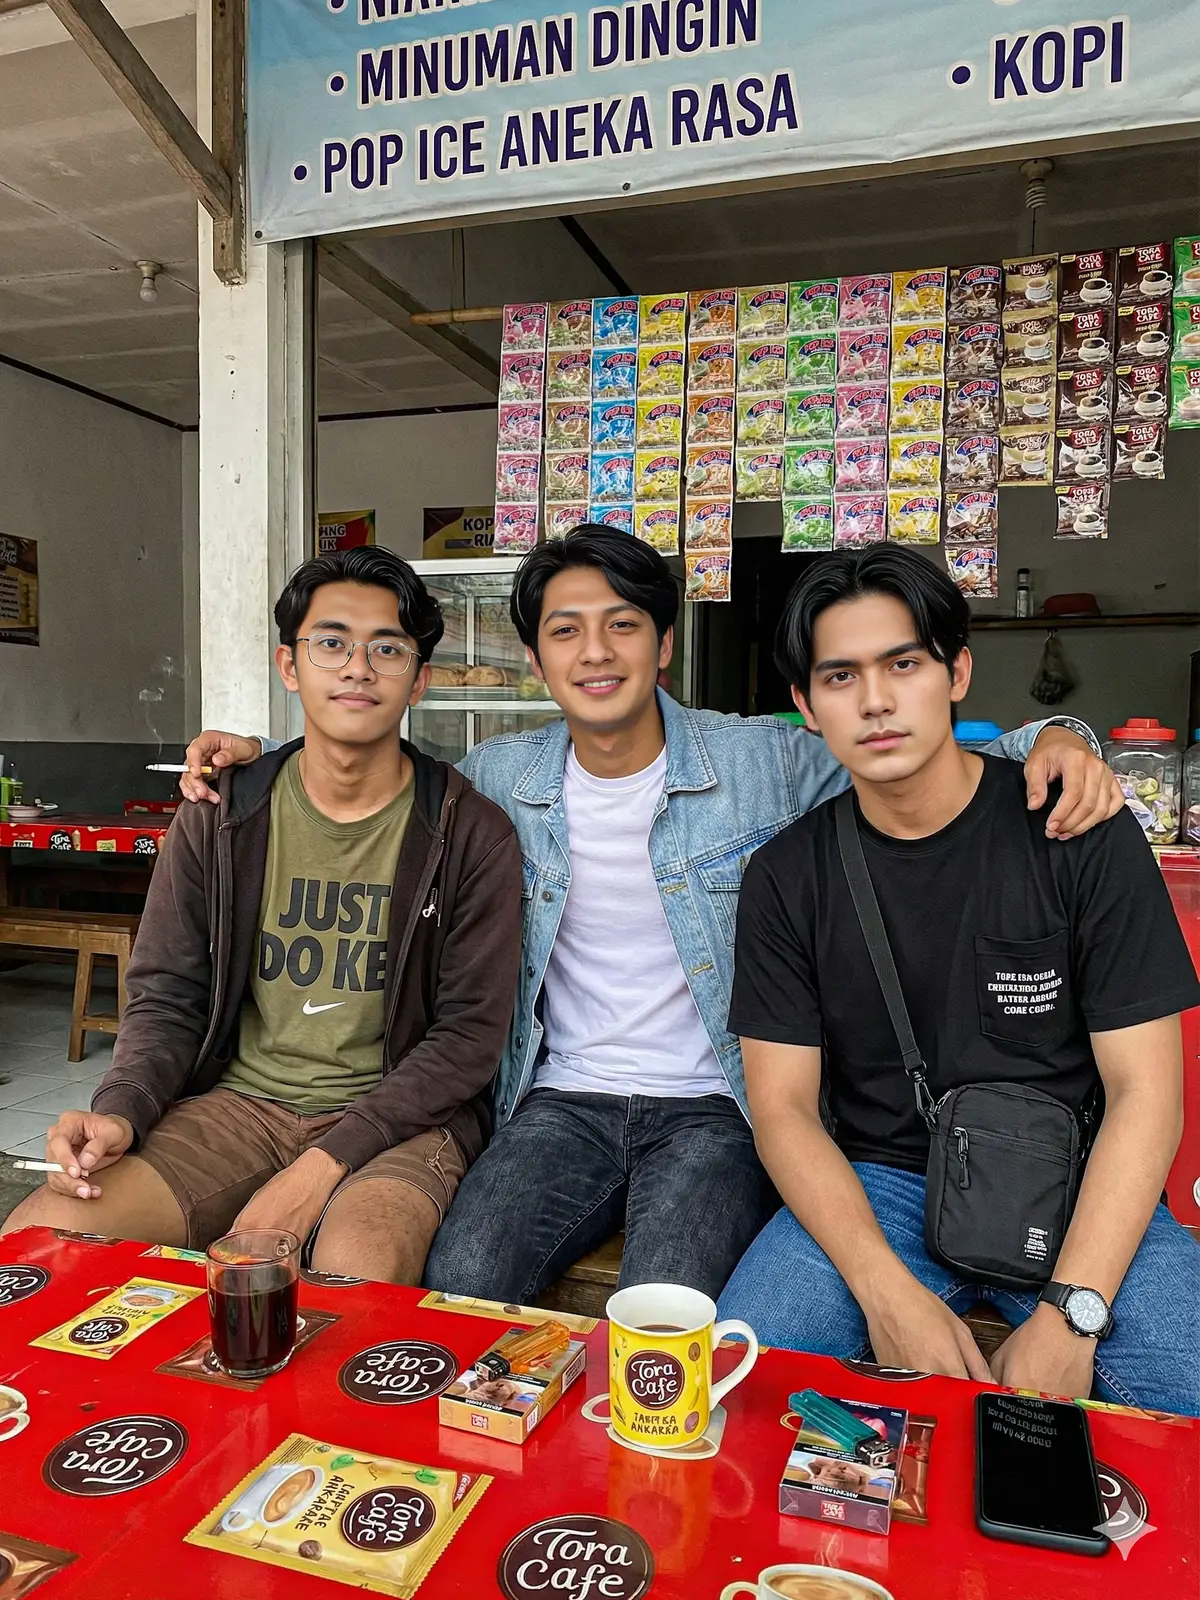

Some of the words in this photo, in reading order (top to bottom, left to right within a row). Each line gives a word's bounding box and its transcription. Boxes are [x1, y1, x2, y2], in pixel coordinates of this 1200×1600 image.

[361, 18, 572, 105] MINUMAN
[593, 0, 757, 67] DINGIN
[994, 21, 1124, 100] KOPI
[324, 134, 404, 194] POP
[419, 120, 485, 181] ICE
[500, 96, 653, 170] ANEKA
[672, 73, 798, 146] RASA
[278, 877, 392, 936] JUST
[258, 931, 323, 987] DO
[332, 938, 388, 992] KE
[353, 1369, 430, 1396] Tora
[366, 1350, 446, 1375] Cafe
[631, 1360, 677, 1381] Tora
[631, 1378, 678, 1401] Cafe
[85, 1428, 173, 1460] Cafe
[62, 1450, 145, 1485] Tora
[357, 1492, 396, 1542] Cafe
[383, 1496, 425, 1544] Tora
[533, 1528, 633, 1567] Tora
[516, 1559, 625, 1600] Cafe
